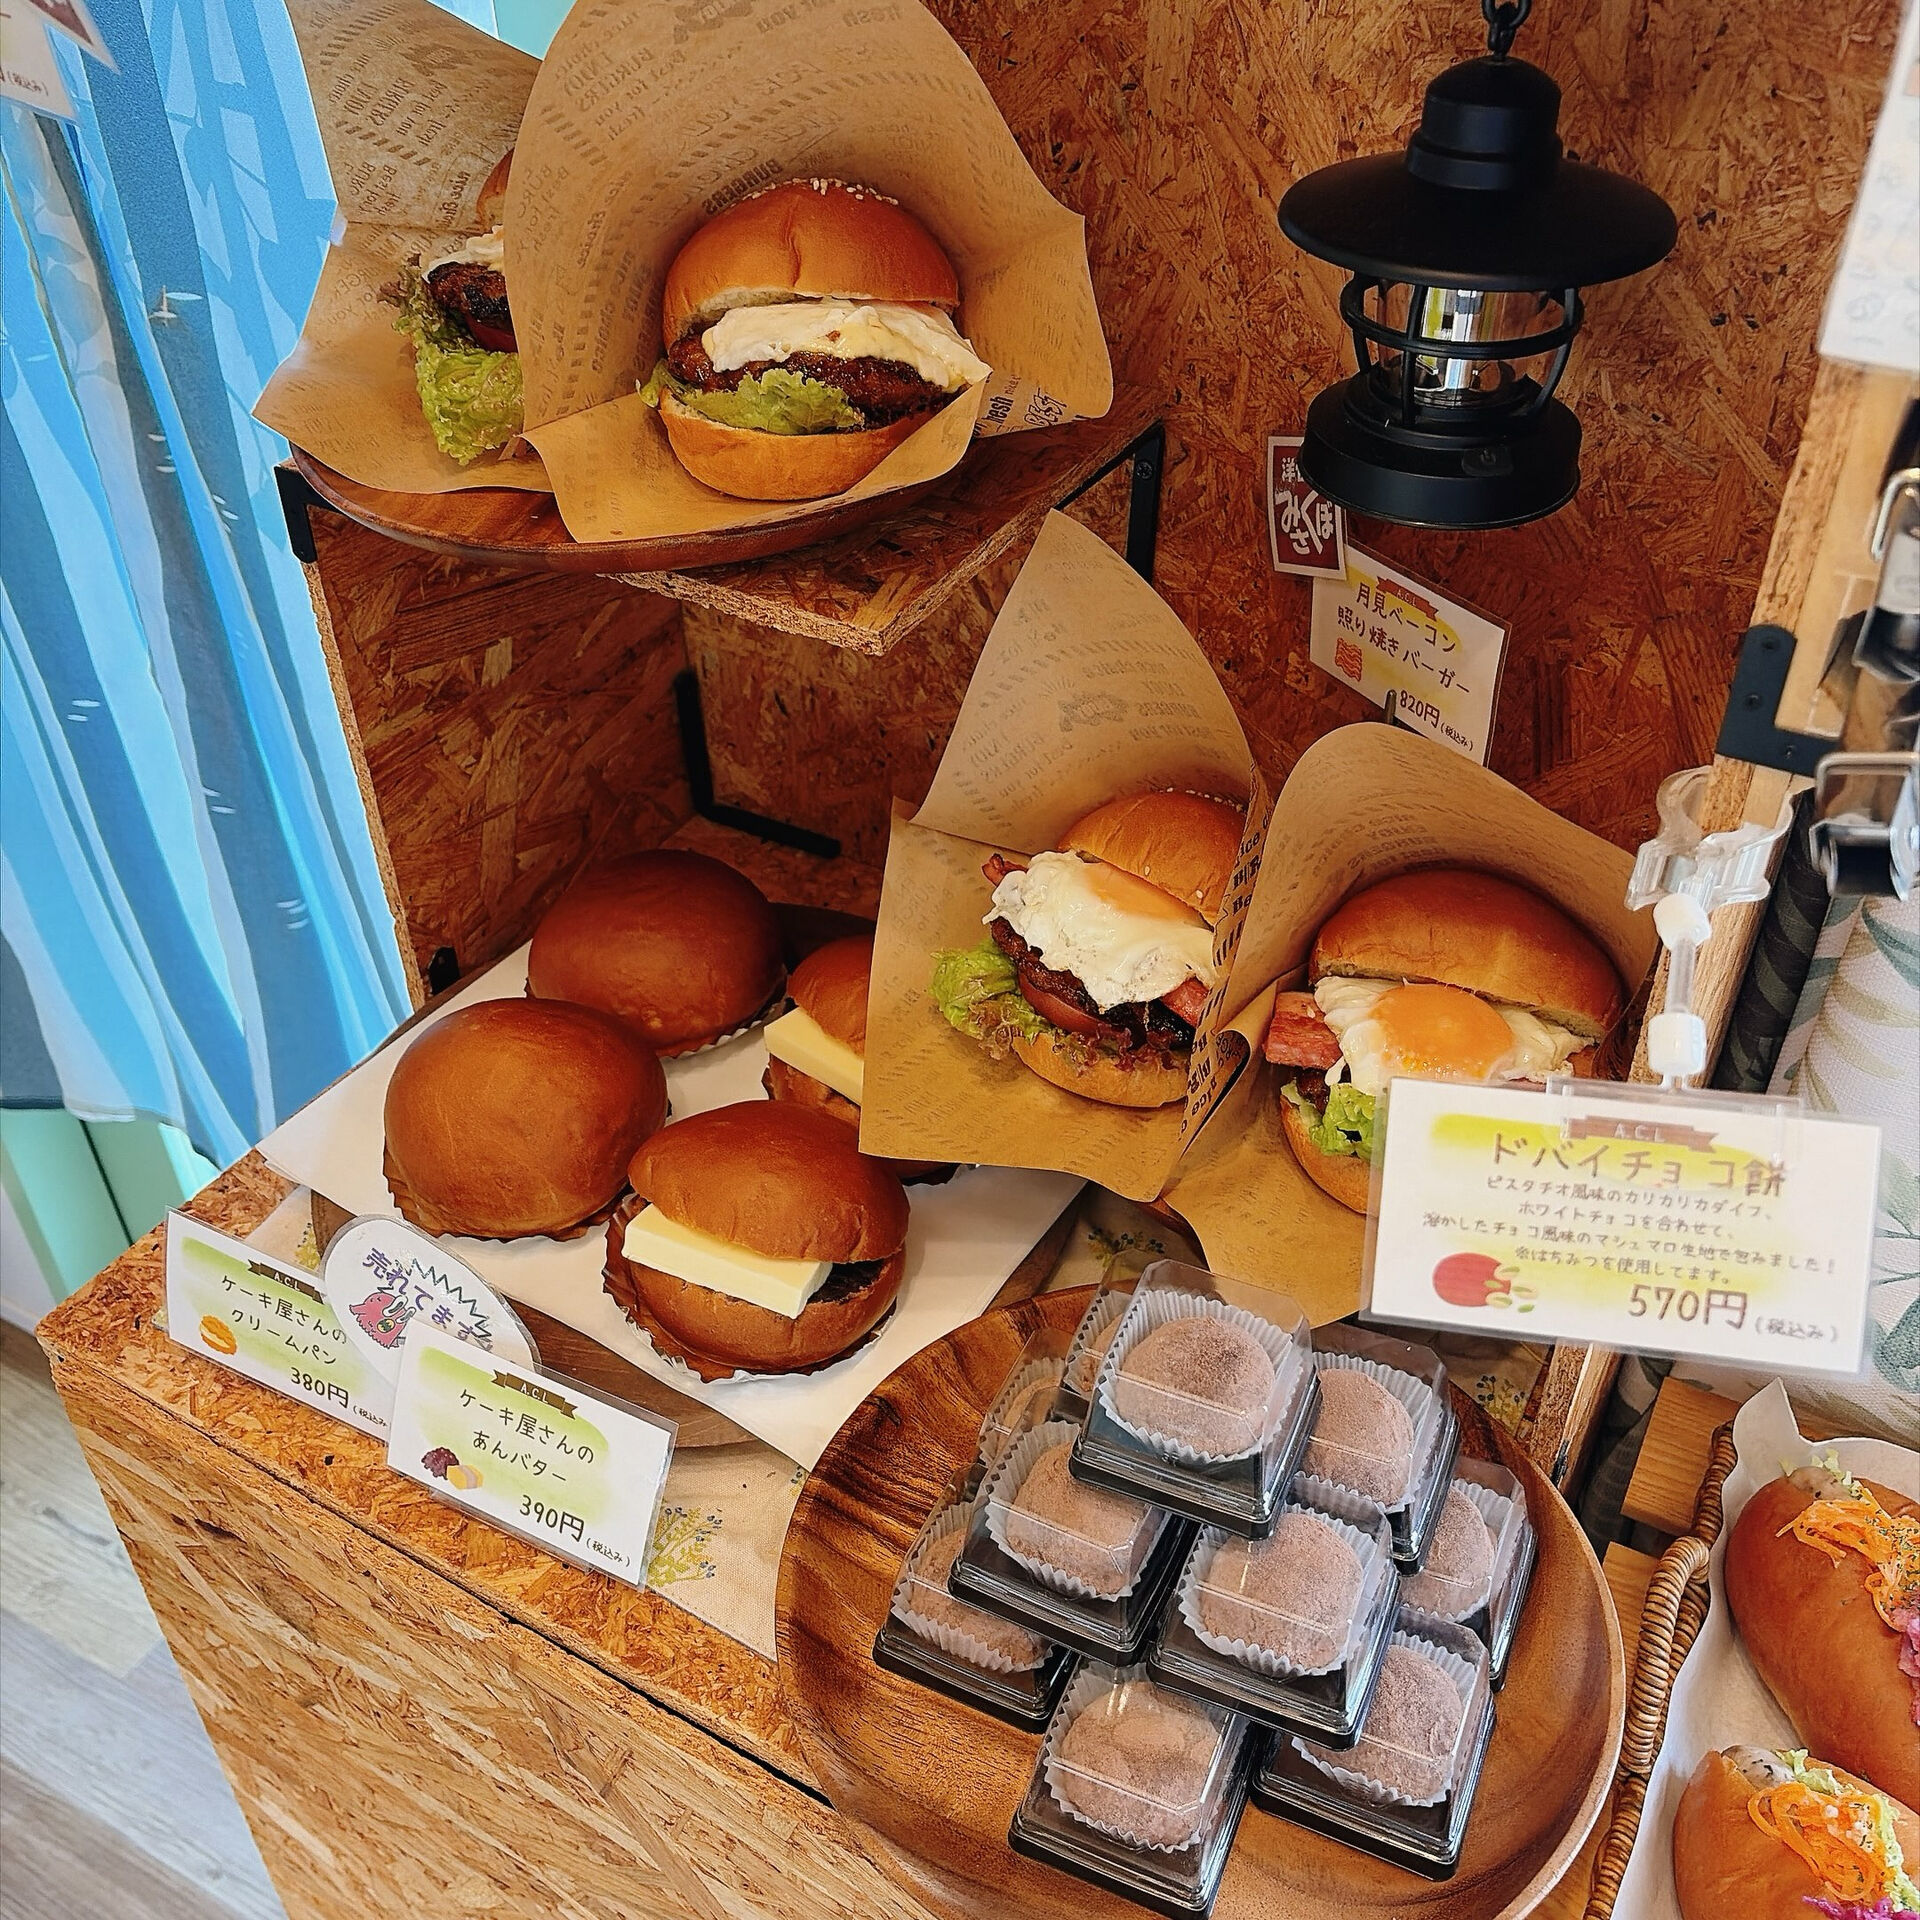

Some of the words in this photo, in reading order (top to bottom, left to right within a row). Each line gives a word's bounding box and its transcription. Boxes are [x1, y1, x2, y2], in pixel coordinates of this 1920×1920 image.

[1337, 605, 1470, 693] 照り焼きバーガー
[1356, 582, 1456, 653] 月見ベーコン
[1399, 690, 1441, 729] 820円
[1494, 1132, 1786, 1197] ドバイチョコ餅
[222, 1275, 347, 1345] ケーキ屋さんの
[232, 1309, 337, 1365] クリームパン
[1627, 1282, 1748, 1330] 570円
[291, 1367, 349, 1409] 380円
[352, 1404, 388, 1428] (税込み
[460, 1389, 594, 1464] ケーキ屋さんの
[473, 1430, 567, 1482] あんバター
[520, 1494, 584, 1543] 390円
[586, 1538, 631, 1567] (税込み)
